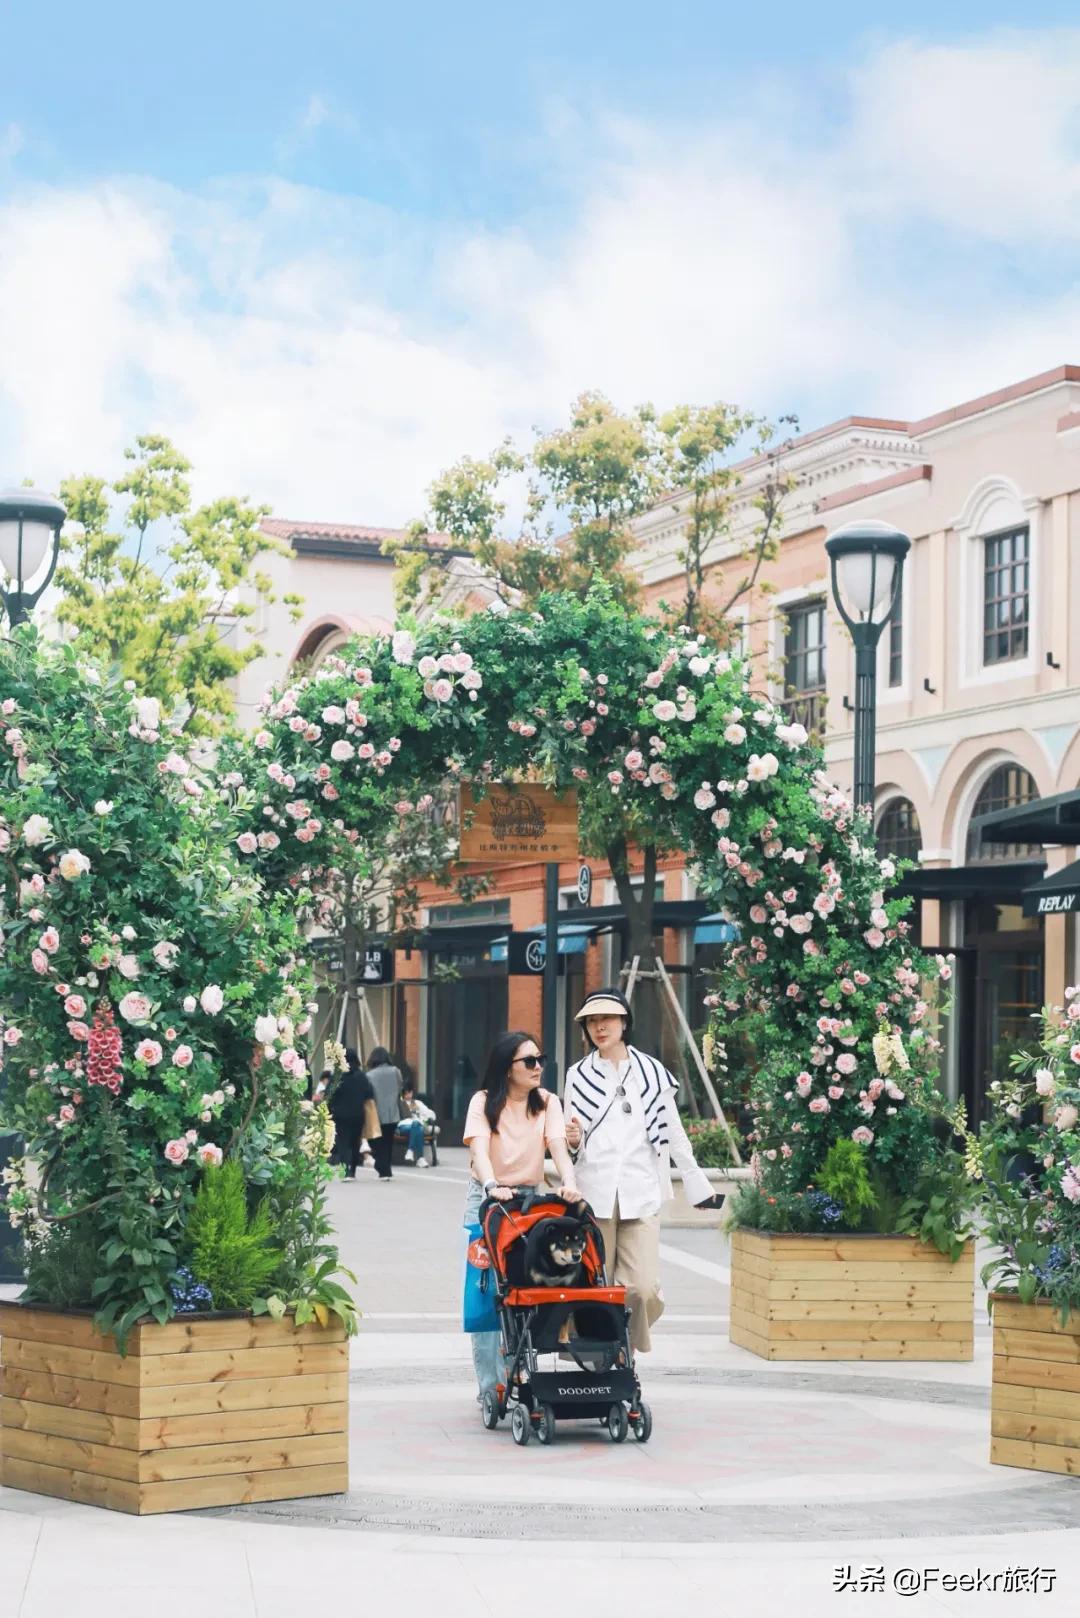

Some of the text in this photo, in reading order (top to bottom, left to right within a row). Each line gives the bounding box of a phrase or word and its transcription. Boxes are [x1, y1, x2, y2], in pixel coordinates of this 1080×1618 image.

[1037, 894, 1076, 912] REPLAY
[355, 951, 381, 962] LB
[558, 1386, 612, 1396] DODOPET
